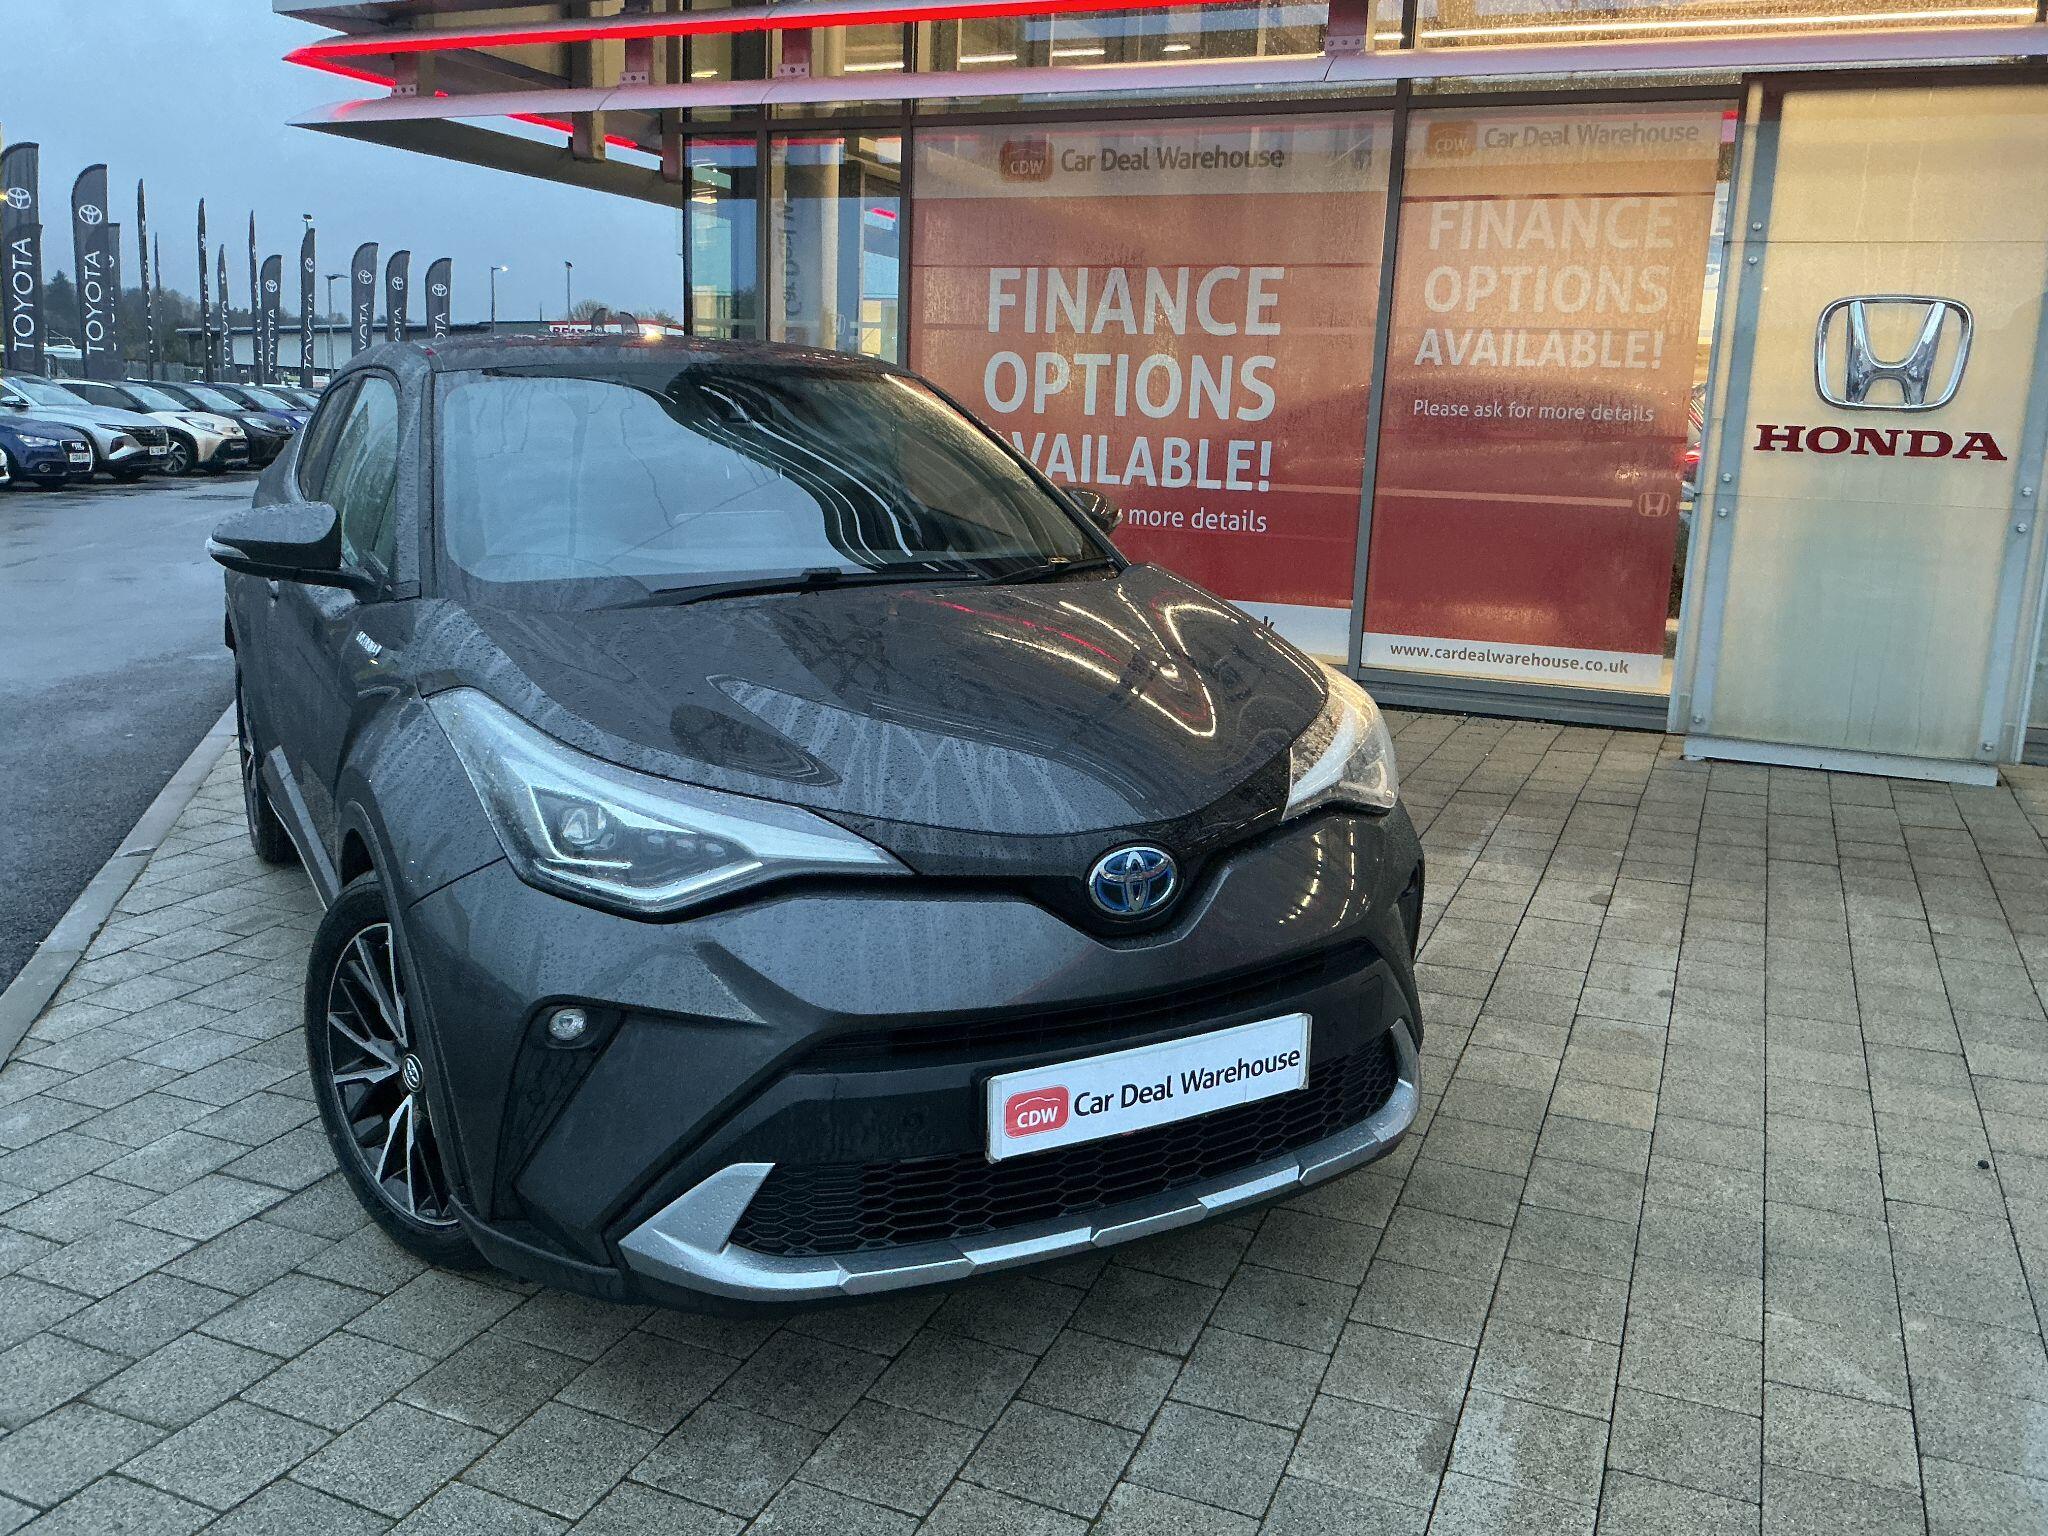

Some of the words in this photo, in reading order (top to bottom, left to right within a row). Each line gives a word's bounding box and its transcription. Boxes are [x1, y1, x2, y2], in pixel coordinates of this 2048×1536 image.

[1435, 137, 1469, 152] CDW
[1484, 127, 1519, 149] Car
[1523, 124, 1569, 148] Deal
[1576, 122, 1699, 147] Warehouse
[1009, 158, 1044, 176] CDW
[1060, 148, 1098, 173] Car
[1101, 145, 1150, 172] Deal
[1156, 144, 1286, 171] Warehouse
[1428, 197, 1679, 251] FINANCE
[12, 237, 35, 352] TOYOTA
[84, 250, 105, 355] TOYOTA
[988, 266, 1285, 337] FINANCE
[1424, 265, 1670, 315] OPTIONS
[1414, 328, 1664, 370] AVAILABLE!
[983, 351, 1278, 422] OPTIONS
[1413, 399, 1470, 418] Please
[1473, 400, 1502, 418] ask
[1508, 401, 1534, 419] for
[1538, 405, 1586, 421] more
[1591, 403, 1655, 423] details
[1011, 431, 1273, 492] VAILABLE!
[1753, 424, 2008, 461] HONDA
[1128, 508, 1184, 528] more
[1191, 506, 1268, 533] details
[1389, 643, 1629, 675] www.cardealwarehouse.co.uk
[1074, 1091, 1115, 1118] Car
[1120, 1075, 1174, 1109] Deal
[1180, 1049, 1301, 1095] Warehouse
[1017, 1105, 1059, 1129] CDW
